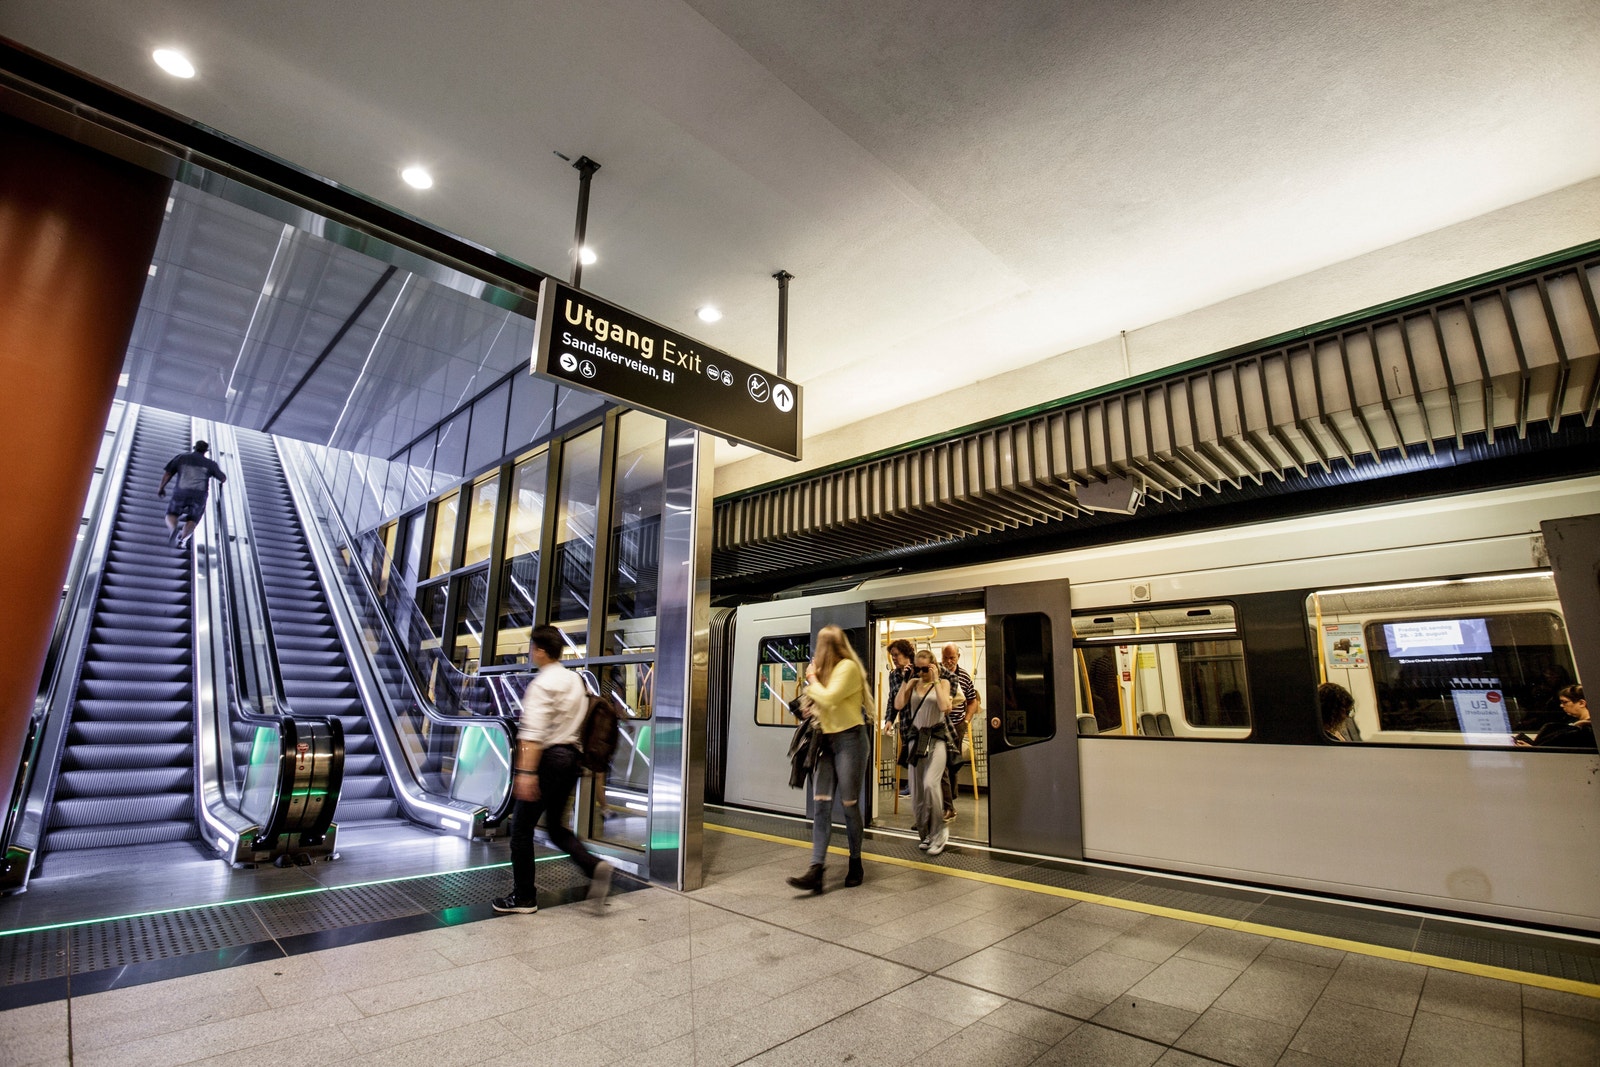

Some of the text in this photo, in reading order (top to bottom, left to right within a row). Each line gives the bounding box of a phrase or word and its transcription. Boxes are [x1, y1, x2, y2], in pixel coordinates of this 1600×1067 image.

[561, 332, 675, 384] Sandakerveien, BI
[565, 299, 702, 374] Utgang Exit
[762, 646, 769, 661] 4
